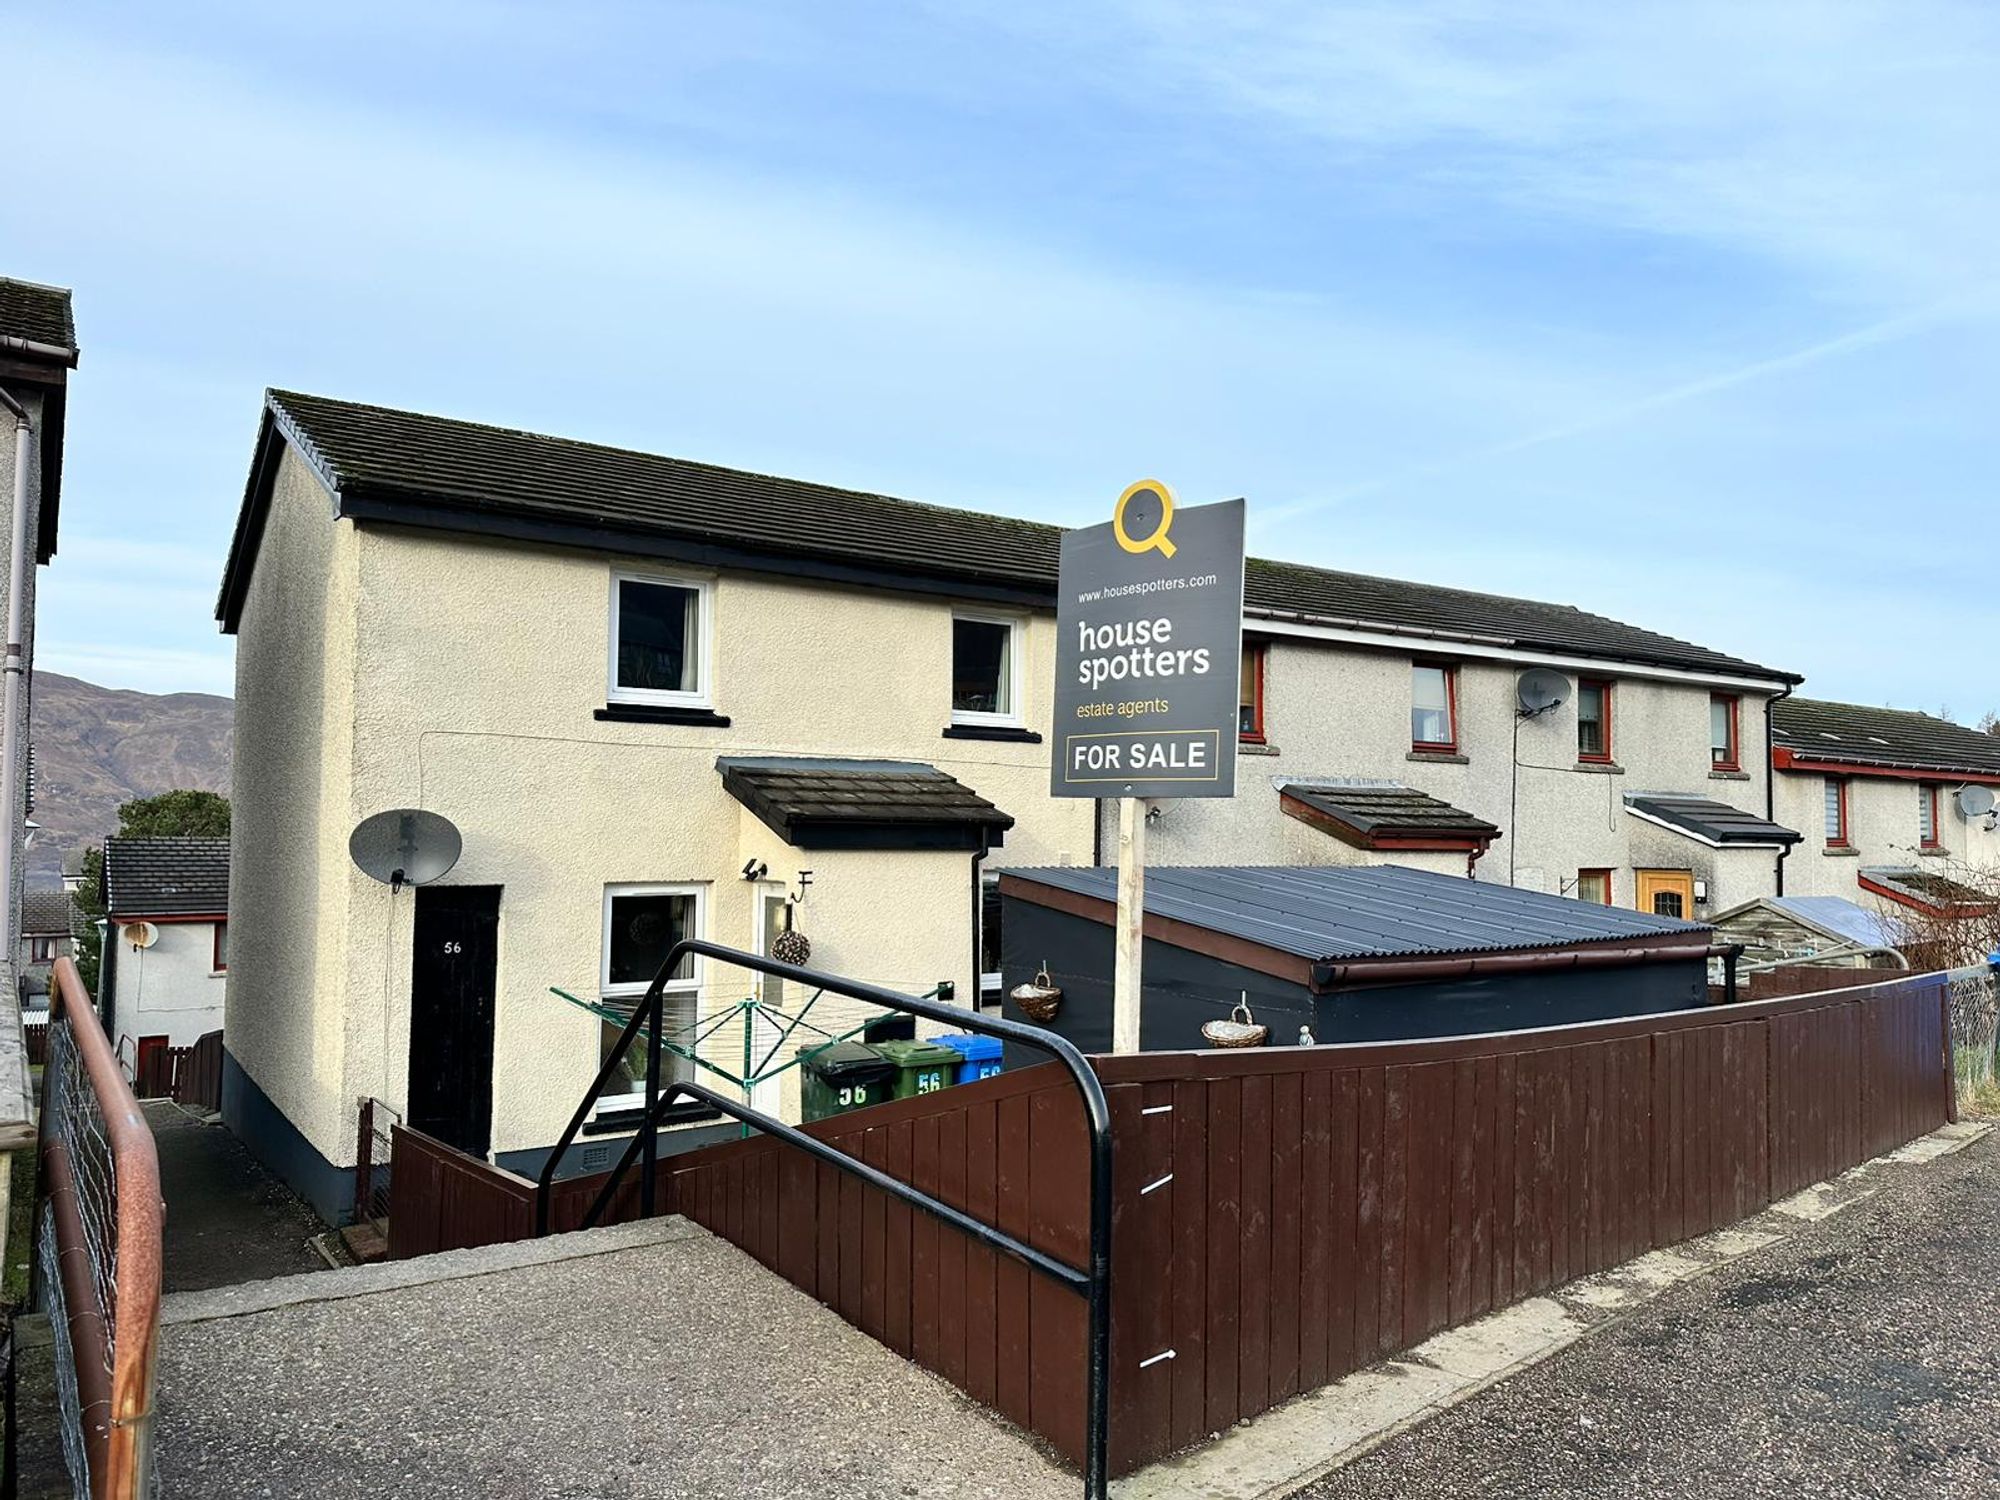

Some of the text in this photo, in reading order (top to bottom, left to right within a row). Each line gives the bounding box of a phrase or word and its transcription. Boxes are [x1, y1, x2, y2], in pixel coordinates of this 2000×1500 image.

[1078, 574, 1217, 603] www.housespotters.com
[1078, 617, 1172, 653] house
[1078, 648, 1210, 690] spotters
[1076, 697, 1169, 719] estate agents
[1074, 742, 1206, 770] FOR SALE
[444, 941, 462, 954] 56
[918, 1072, 941, 1095] 56
